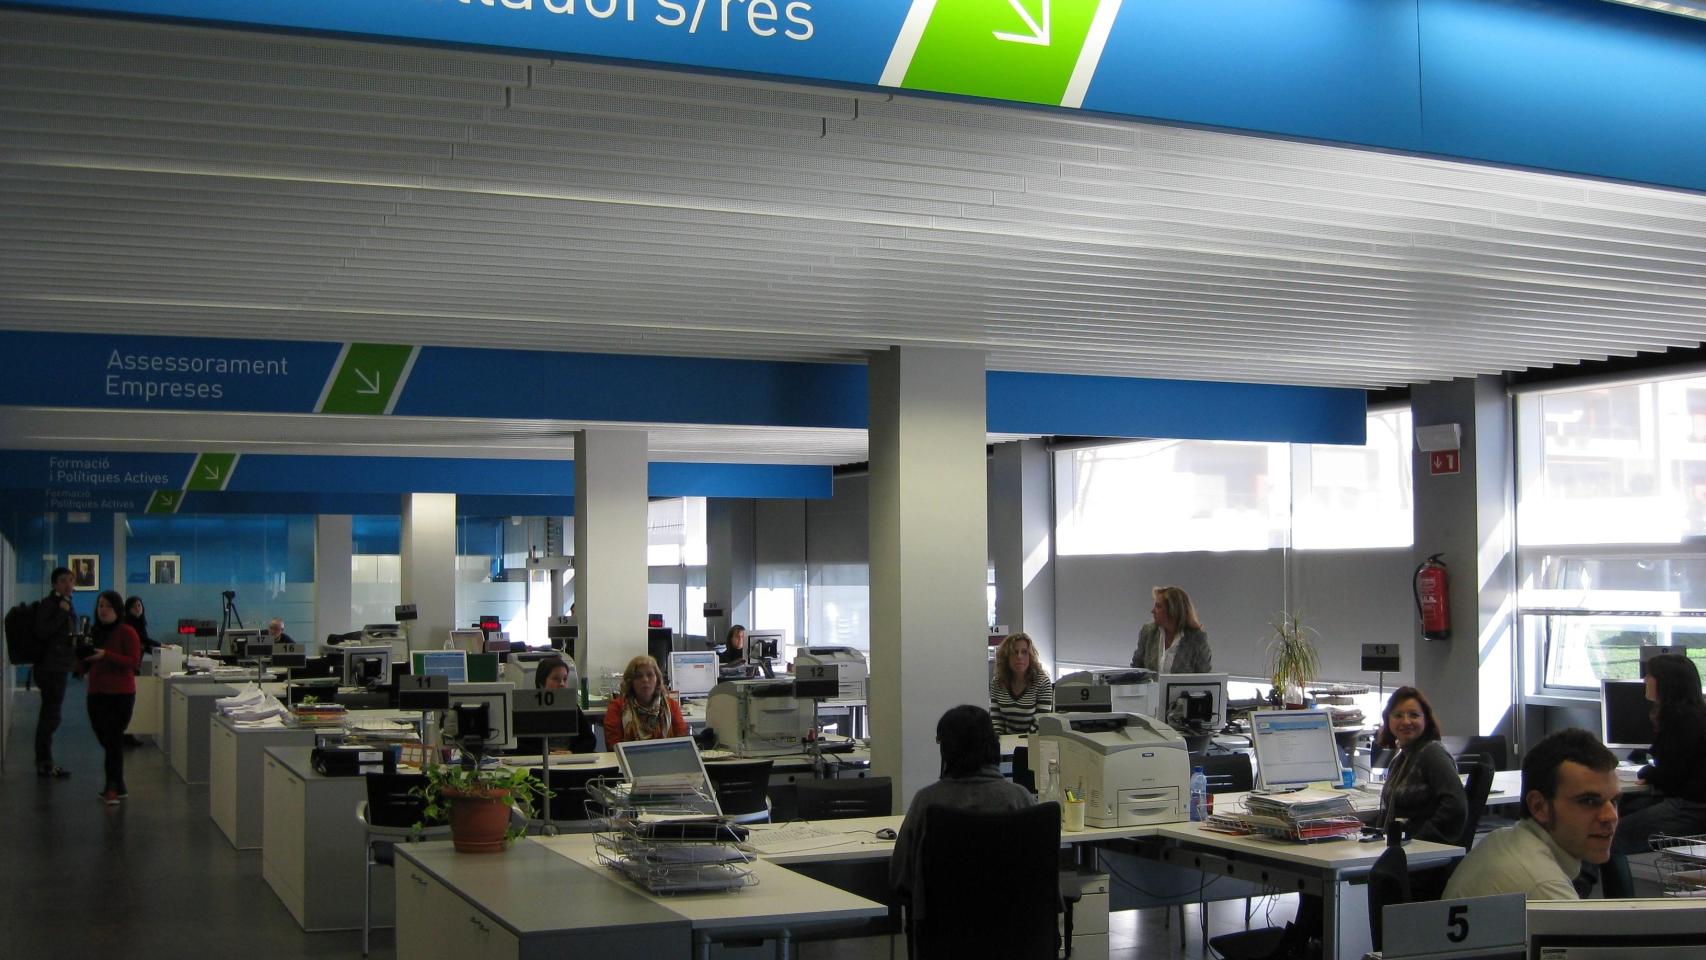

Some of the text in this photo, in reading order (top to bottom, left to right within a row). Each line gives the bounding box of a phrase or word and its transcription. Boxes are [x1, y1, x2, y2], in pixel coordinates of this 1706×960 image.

[457, 0, 815, 41] ors/res
[106, 349, 289, 376] Assessorament
[105, 374, 224, 401] Empreses
[49, 456, 110, 469] Formació
[1446, 454, 1454, 470] 1
[49, 470, 54, 482] i
[123, 471, 169, 484] Actives
[559, 616, 569, 624] 15
[990, 626, 1000, 634] 14
[283, 644, 295, 653] 16
[1374, 645, 1386, 655] 13
[809, 666, 824, 677] 12
[416, 676, 432, 688] 11
[535, 691, 555, 706] 10
[1080, 688, 1090, 701] 9
[1446, 904, 1469, 943] 5
